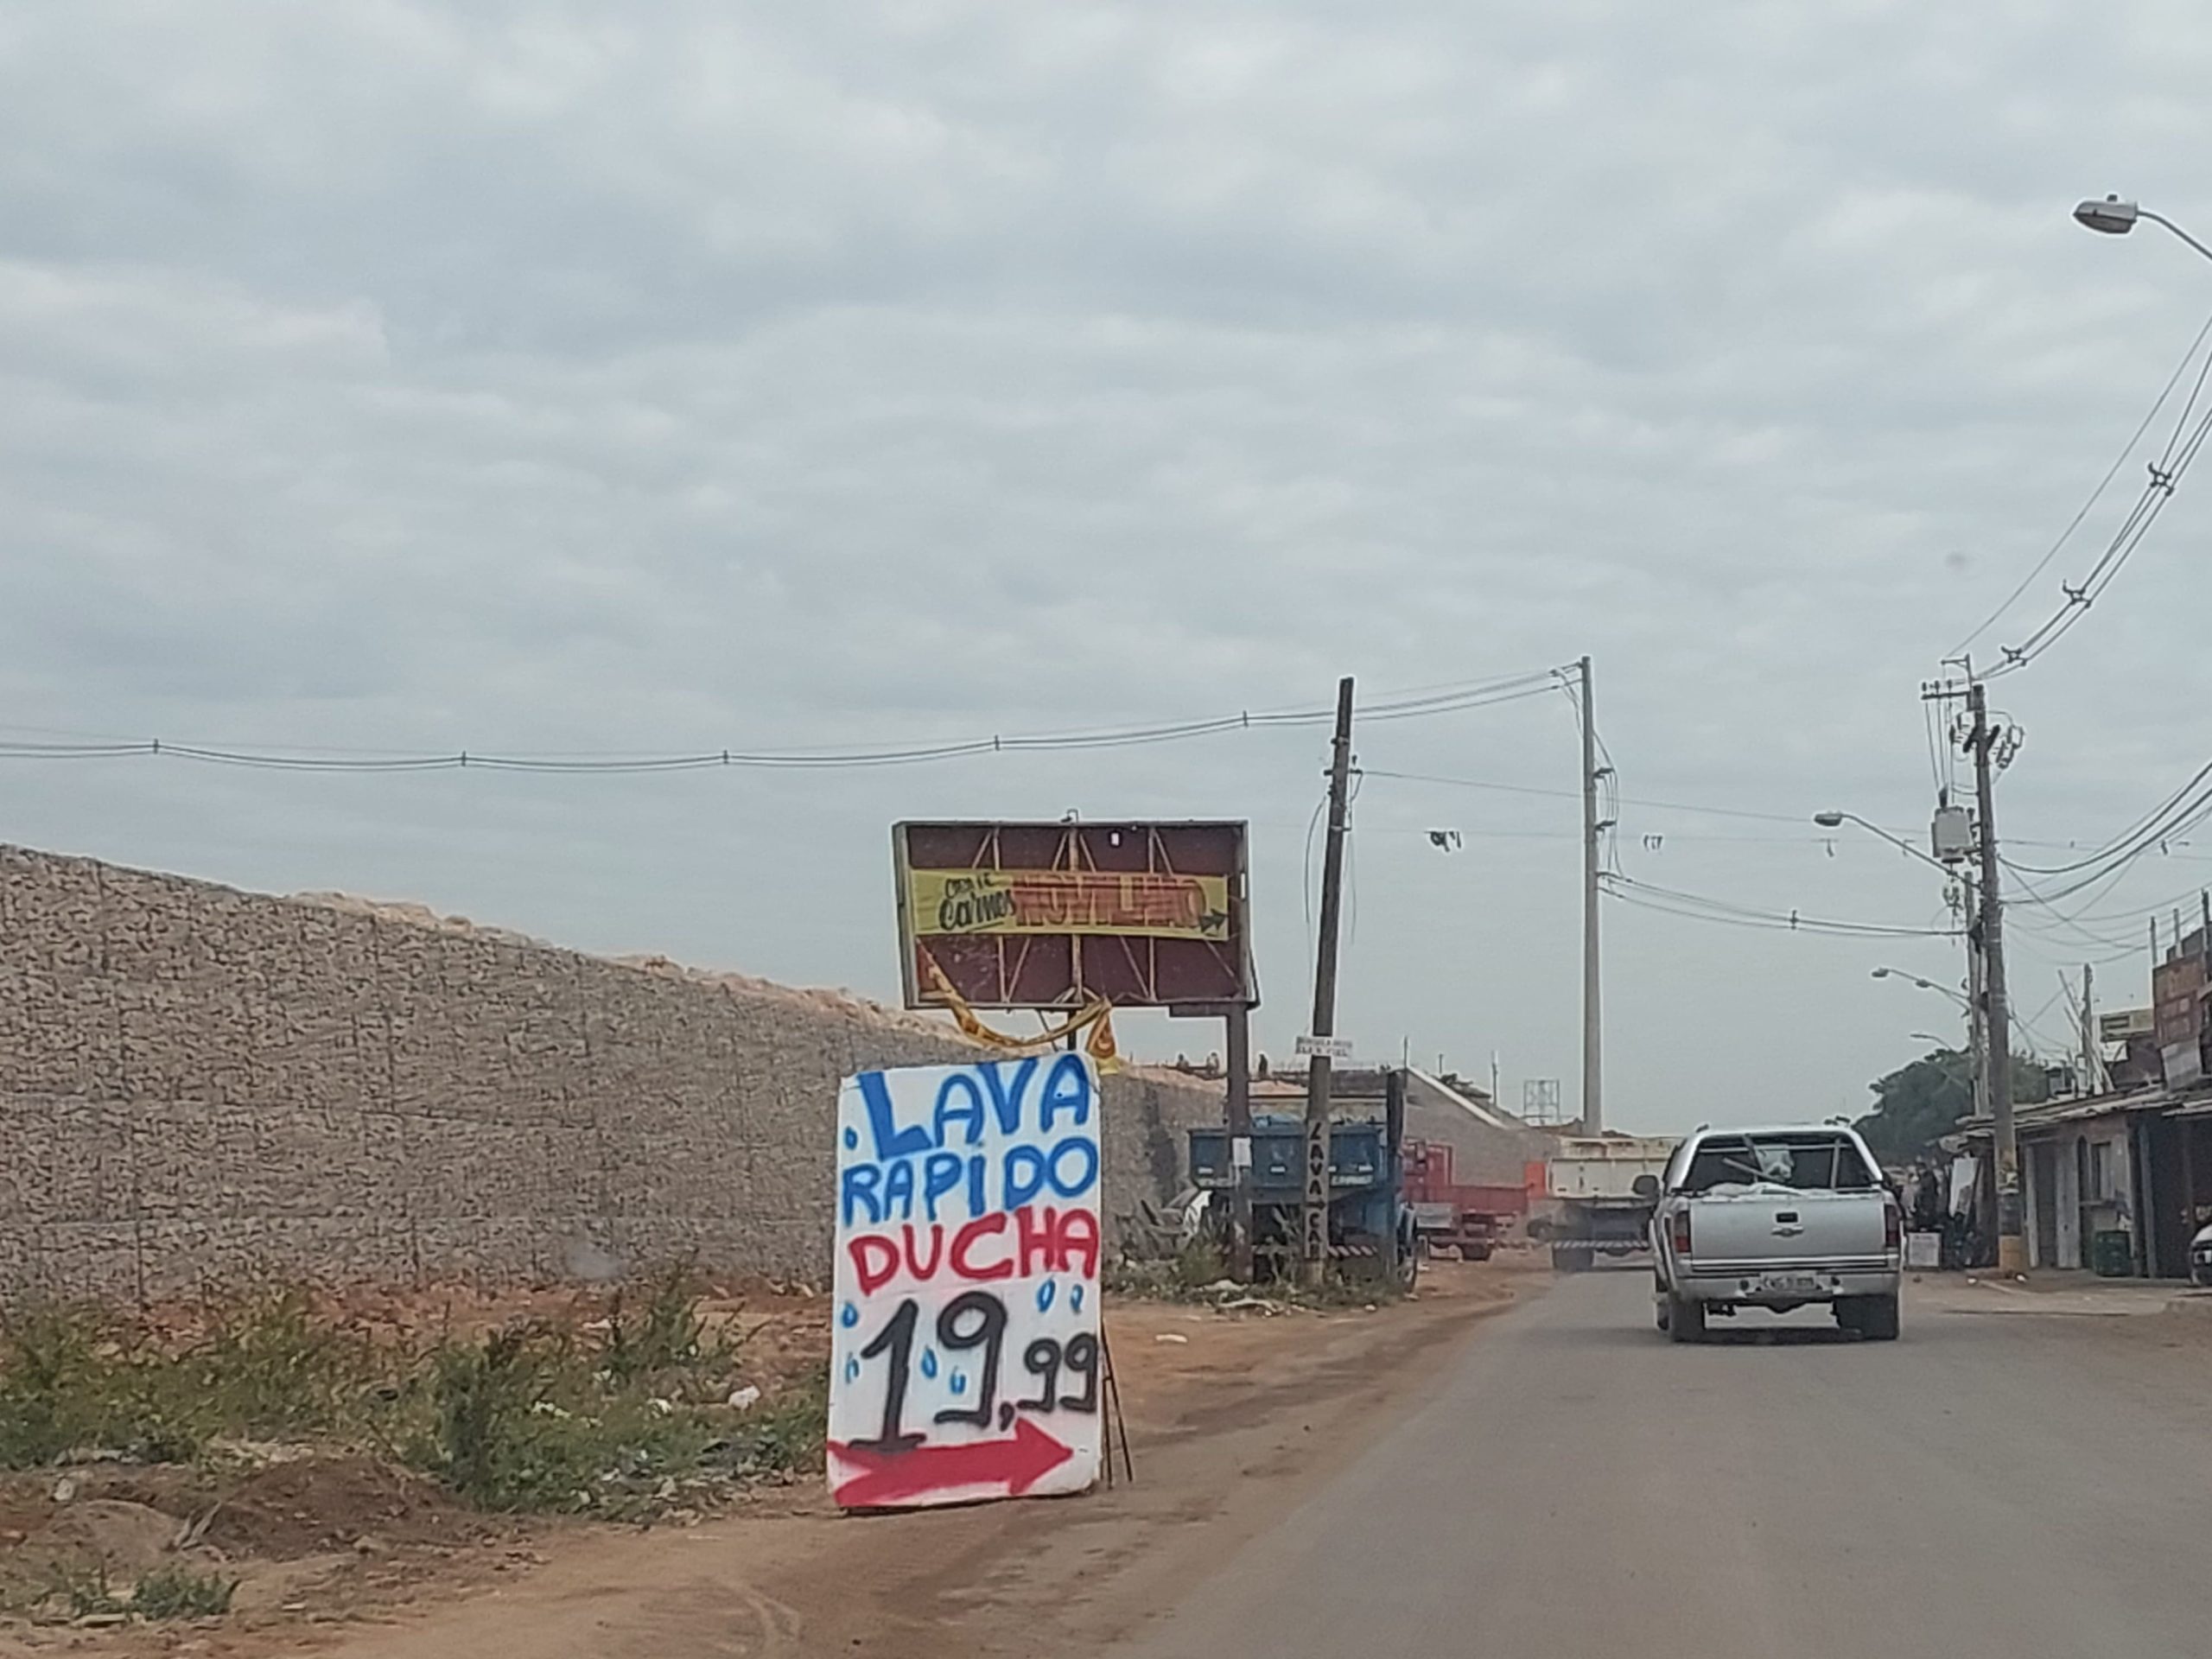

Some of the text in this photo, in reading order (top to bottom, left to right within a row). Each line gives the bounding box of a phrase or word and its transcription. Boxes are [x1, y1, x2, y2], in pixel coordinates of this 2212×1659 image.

[857, 1054, 1091, 1161] LAVA
[842, 1136, 1098, 1227] RAPIDO
[1309, 1121, 1325, 1196] LAVA
[848, 1206, 1098, 1296] DUCHA
[847, 1290, 1099, 1454] 19,99
